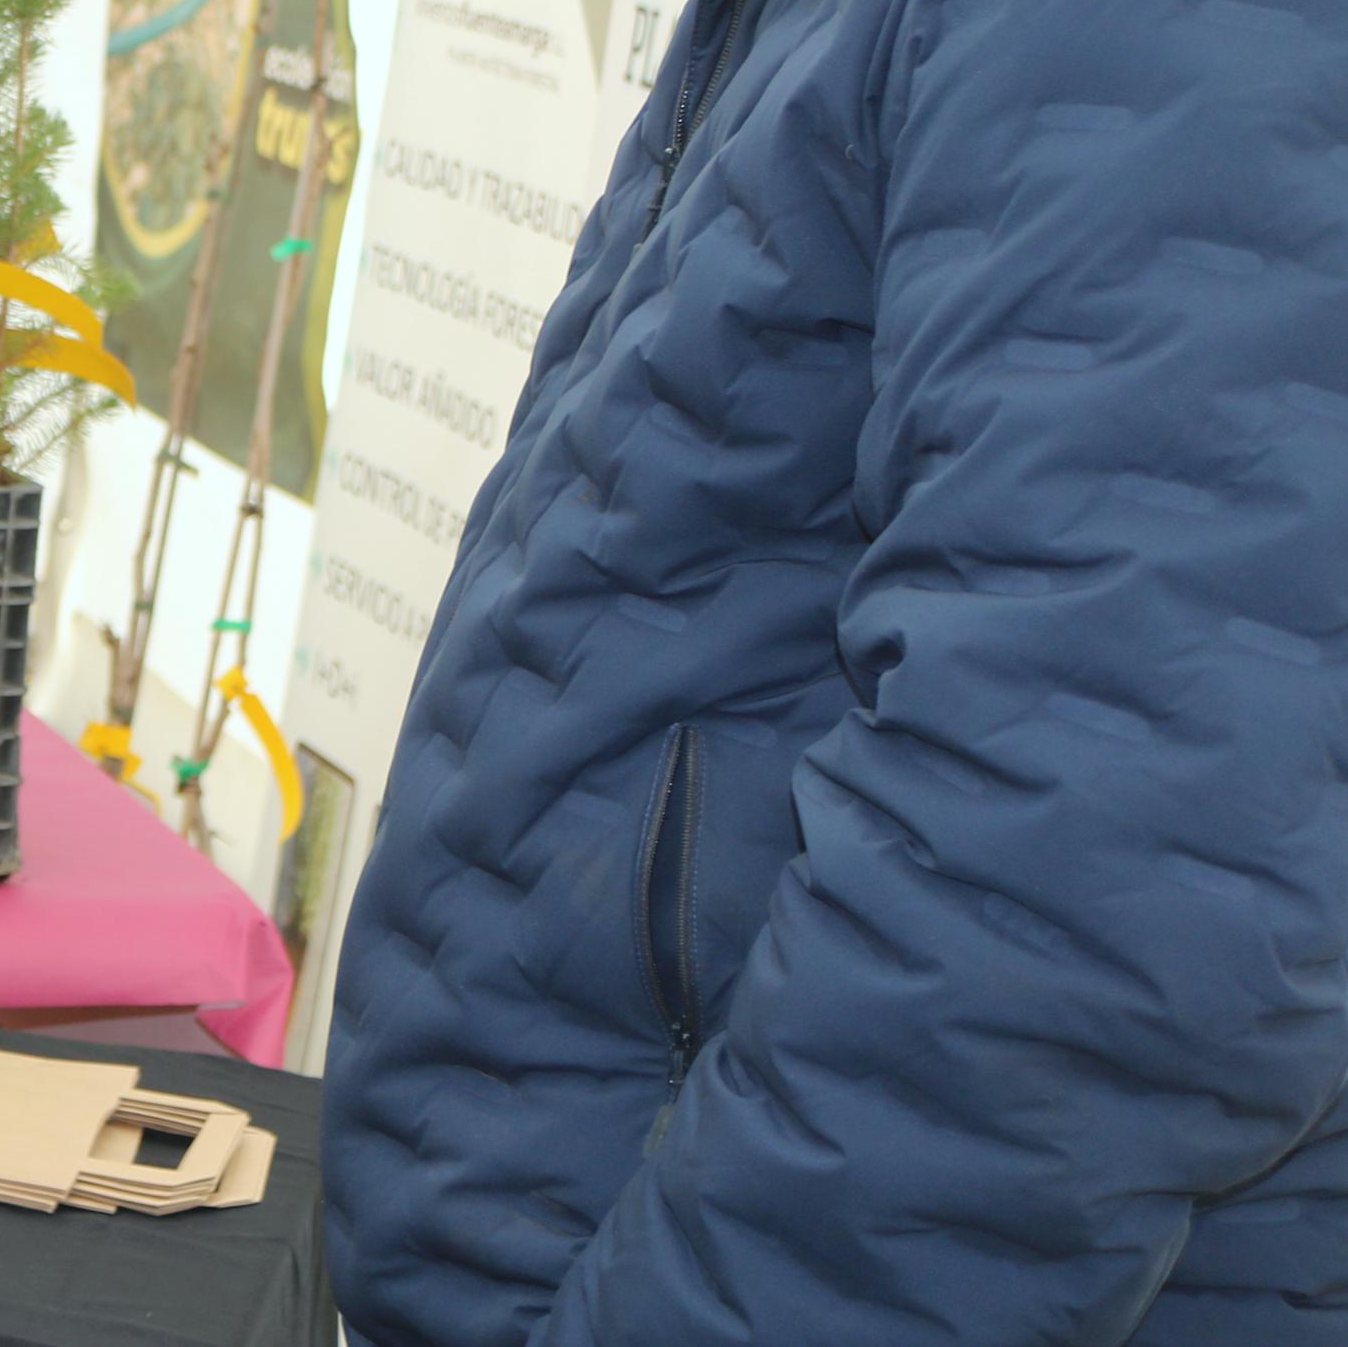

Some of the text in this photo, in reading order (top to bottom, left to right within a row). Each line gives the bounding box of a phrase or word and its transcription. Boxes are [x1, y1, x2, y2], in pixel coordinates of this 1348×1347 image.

[382, 135, 585, 247] CALIDAD Y TRAZABILID
[370, 241, 483, 329] TECNOLOGÍA
[354, 347, 498, 450] VALOR AÑADIDO
[339, 450, 422, 531] CONTROL
[322, 554, 402, 635] SERVICIO
